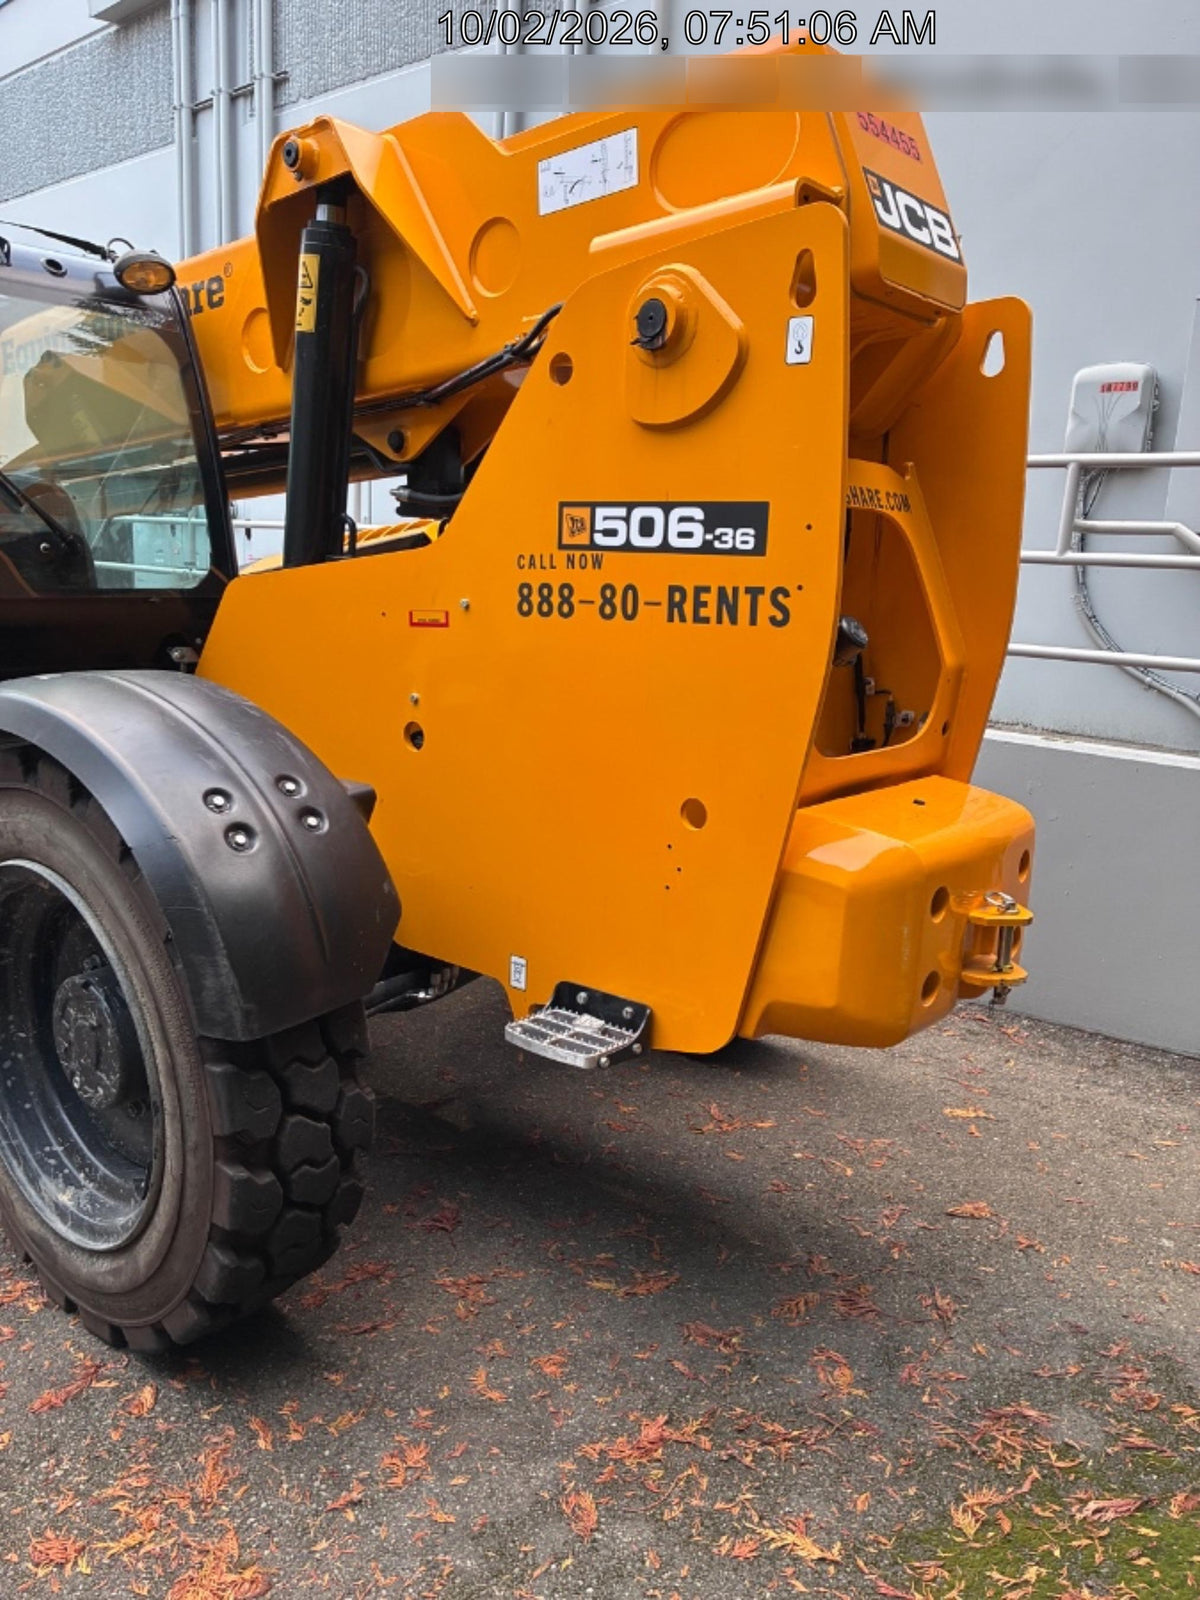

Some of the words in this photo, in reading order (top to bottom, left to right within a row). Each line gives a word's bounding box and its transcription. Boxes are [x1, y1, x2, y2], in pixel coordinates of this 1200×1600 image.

[857, 112, 921, 162] 554455
[874, 182, 959, 259] JCB
[593, 506, 756, 550] 506-36
[516, 553, 557, 570] CALL
[566, 553, 604, 570] NOW
[517, 582, 791, 628] 888-80-RENTS
